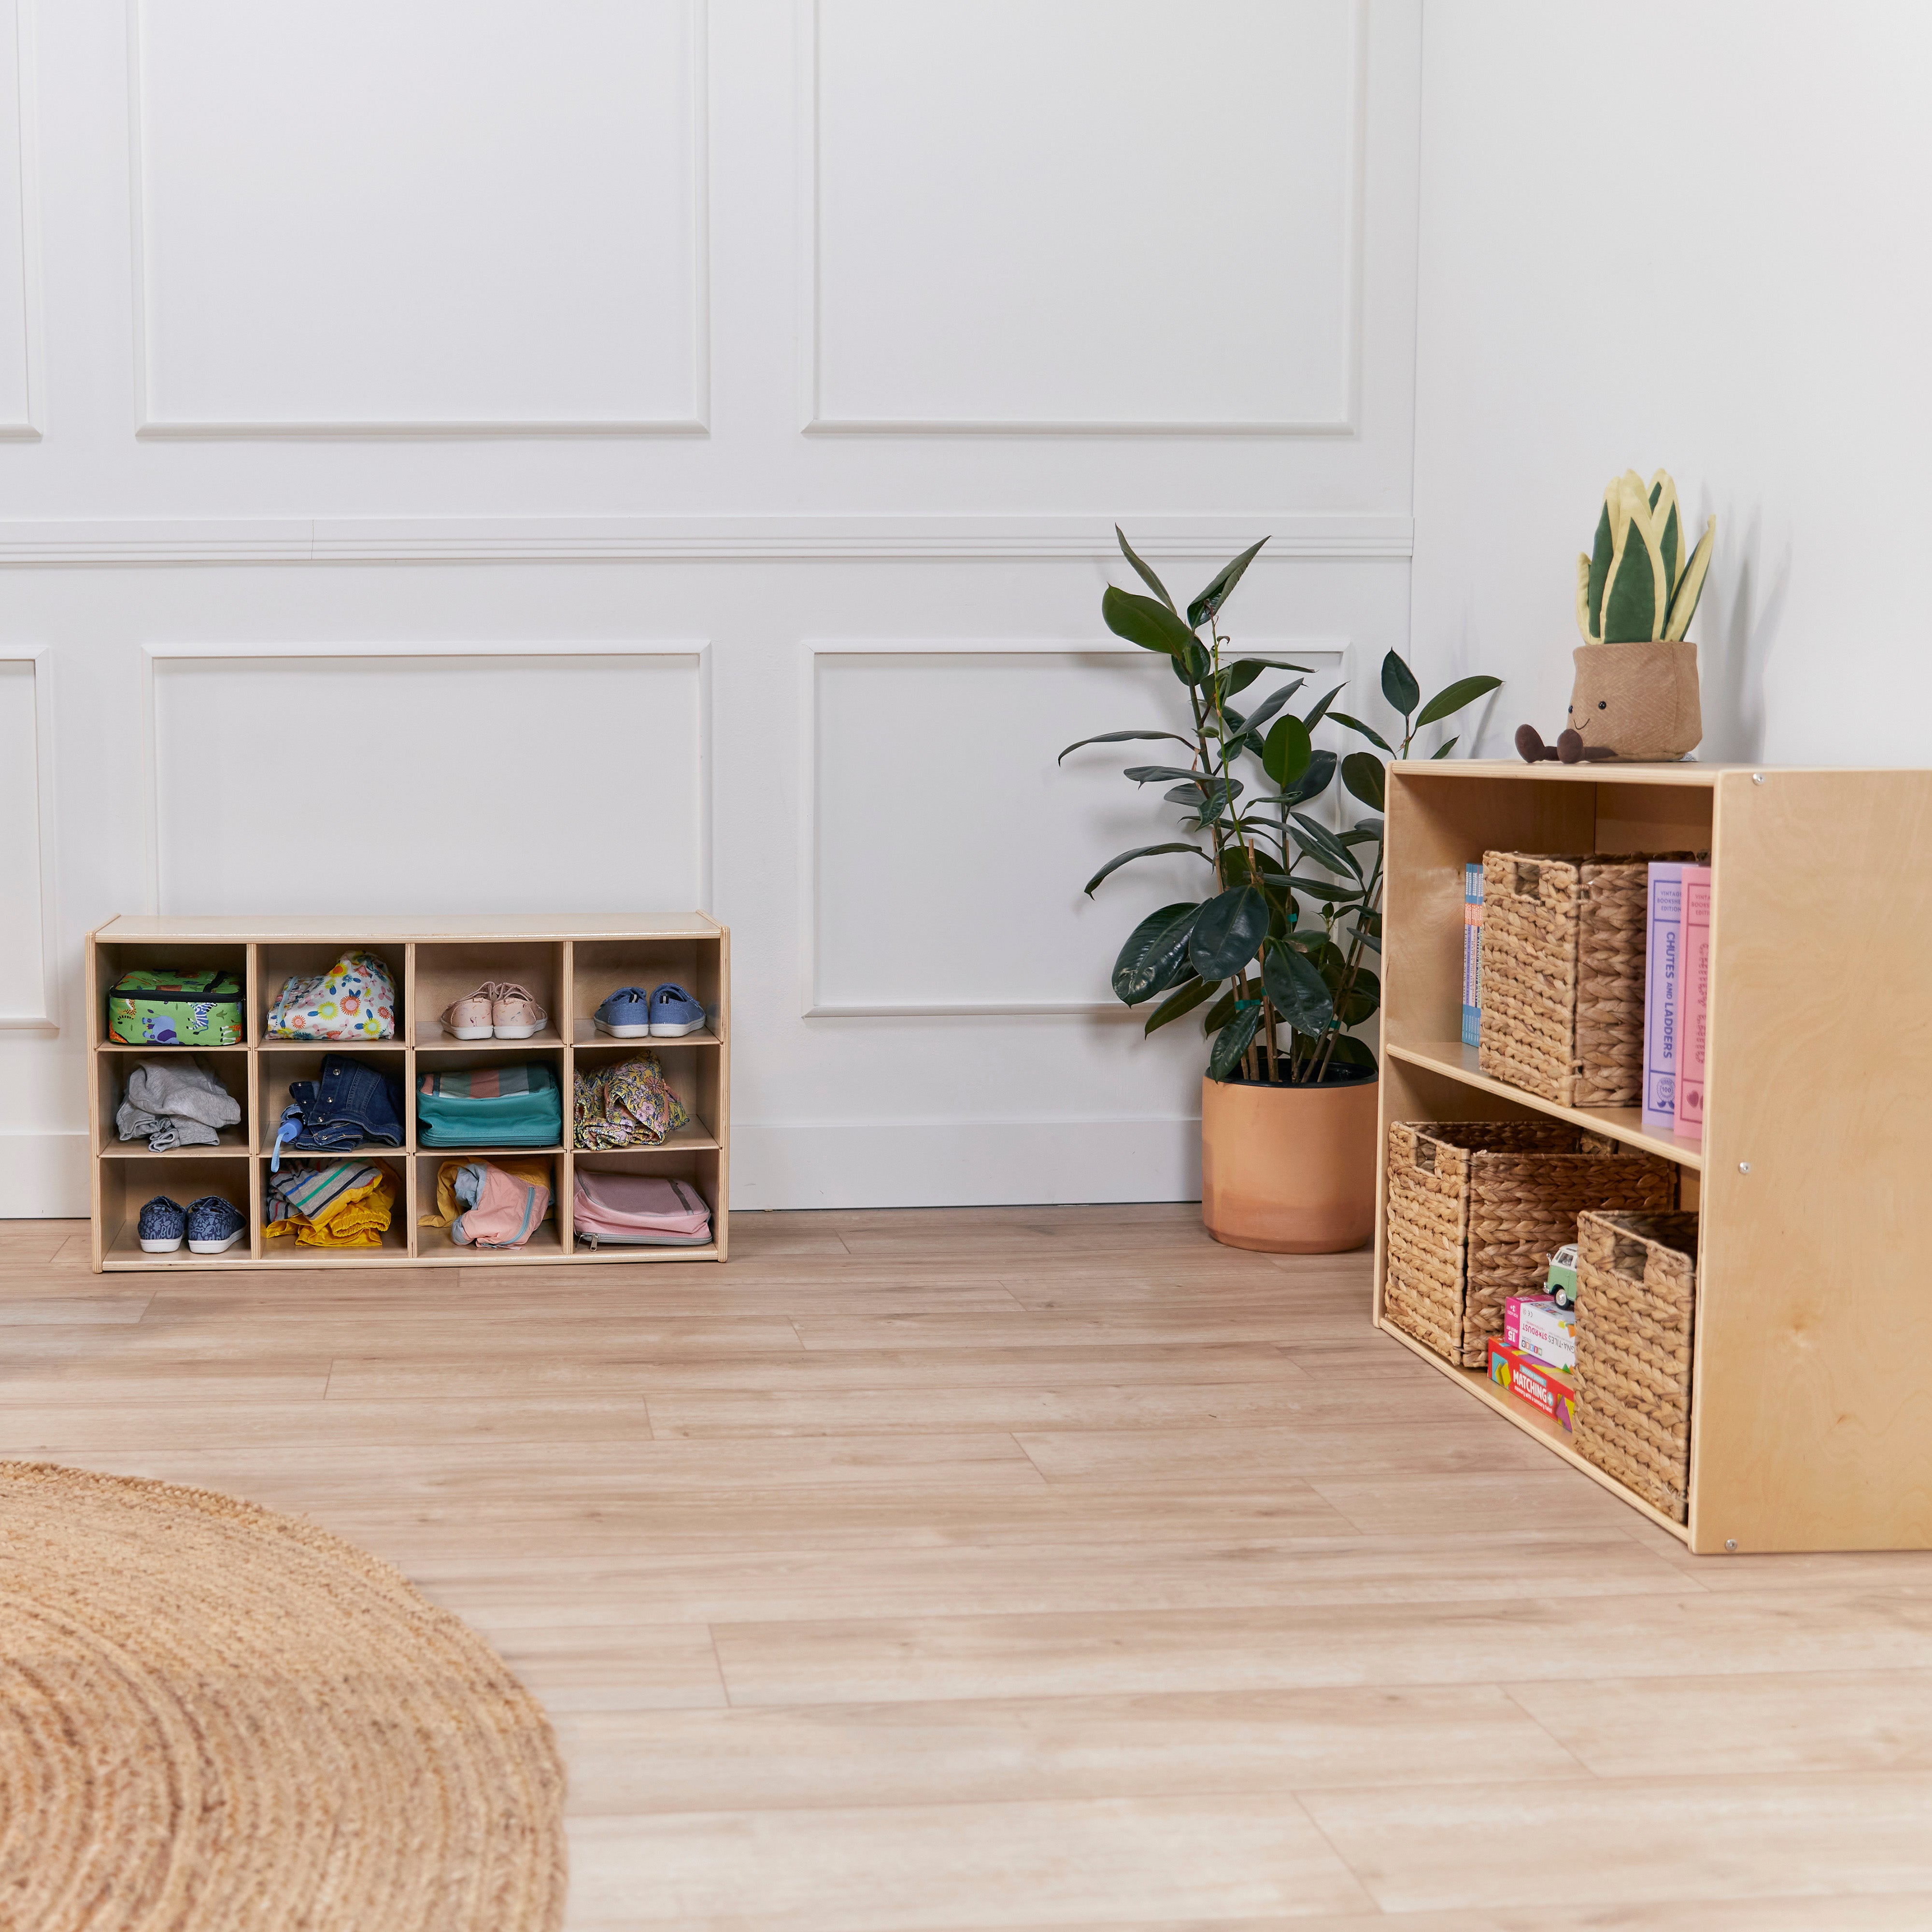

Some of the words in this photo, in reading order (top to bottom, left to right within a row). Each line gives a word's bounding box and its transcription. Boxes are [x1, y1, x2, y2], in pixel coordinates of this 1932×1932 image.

[1665, 932, 1675, 979] CHUTES
[1663, 1002, 1673, 1059] LADDERS
[1508, 1331, 1515, 1342] 15
[1548, 1335, 1575, 1353] GNA-TILES
